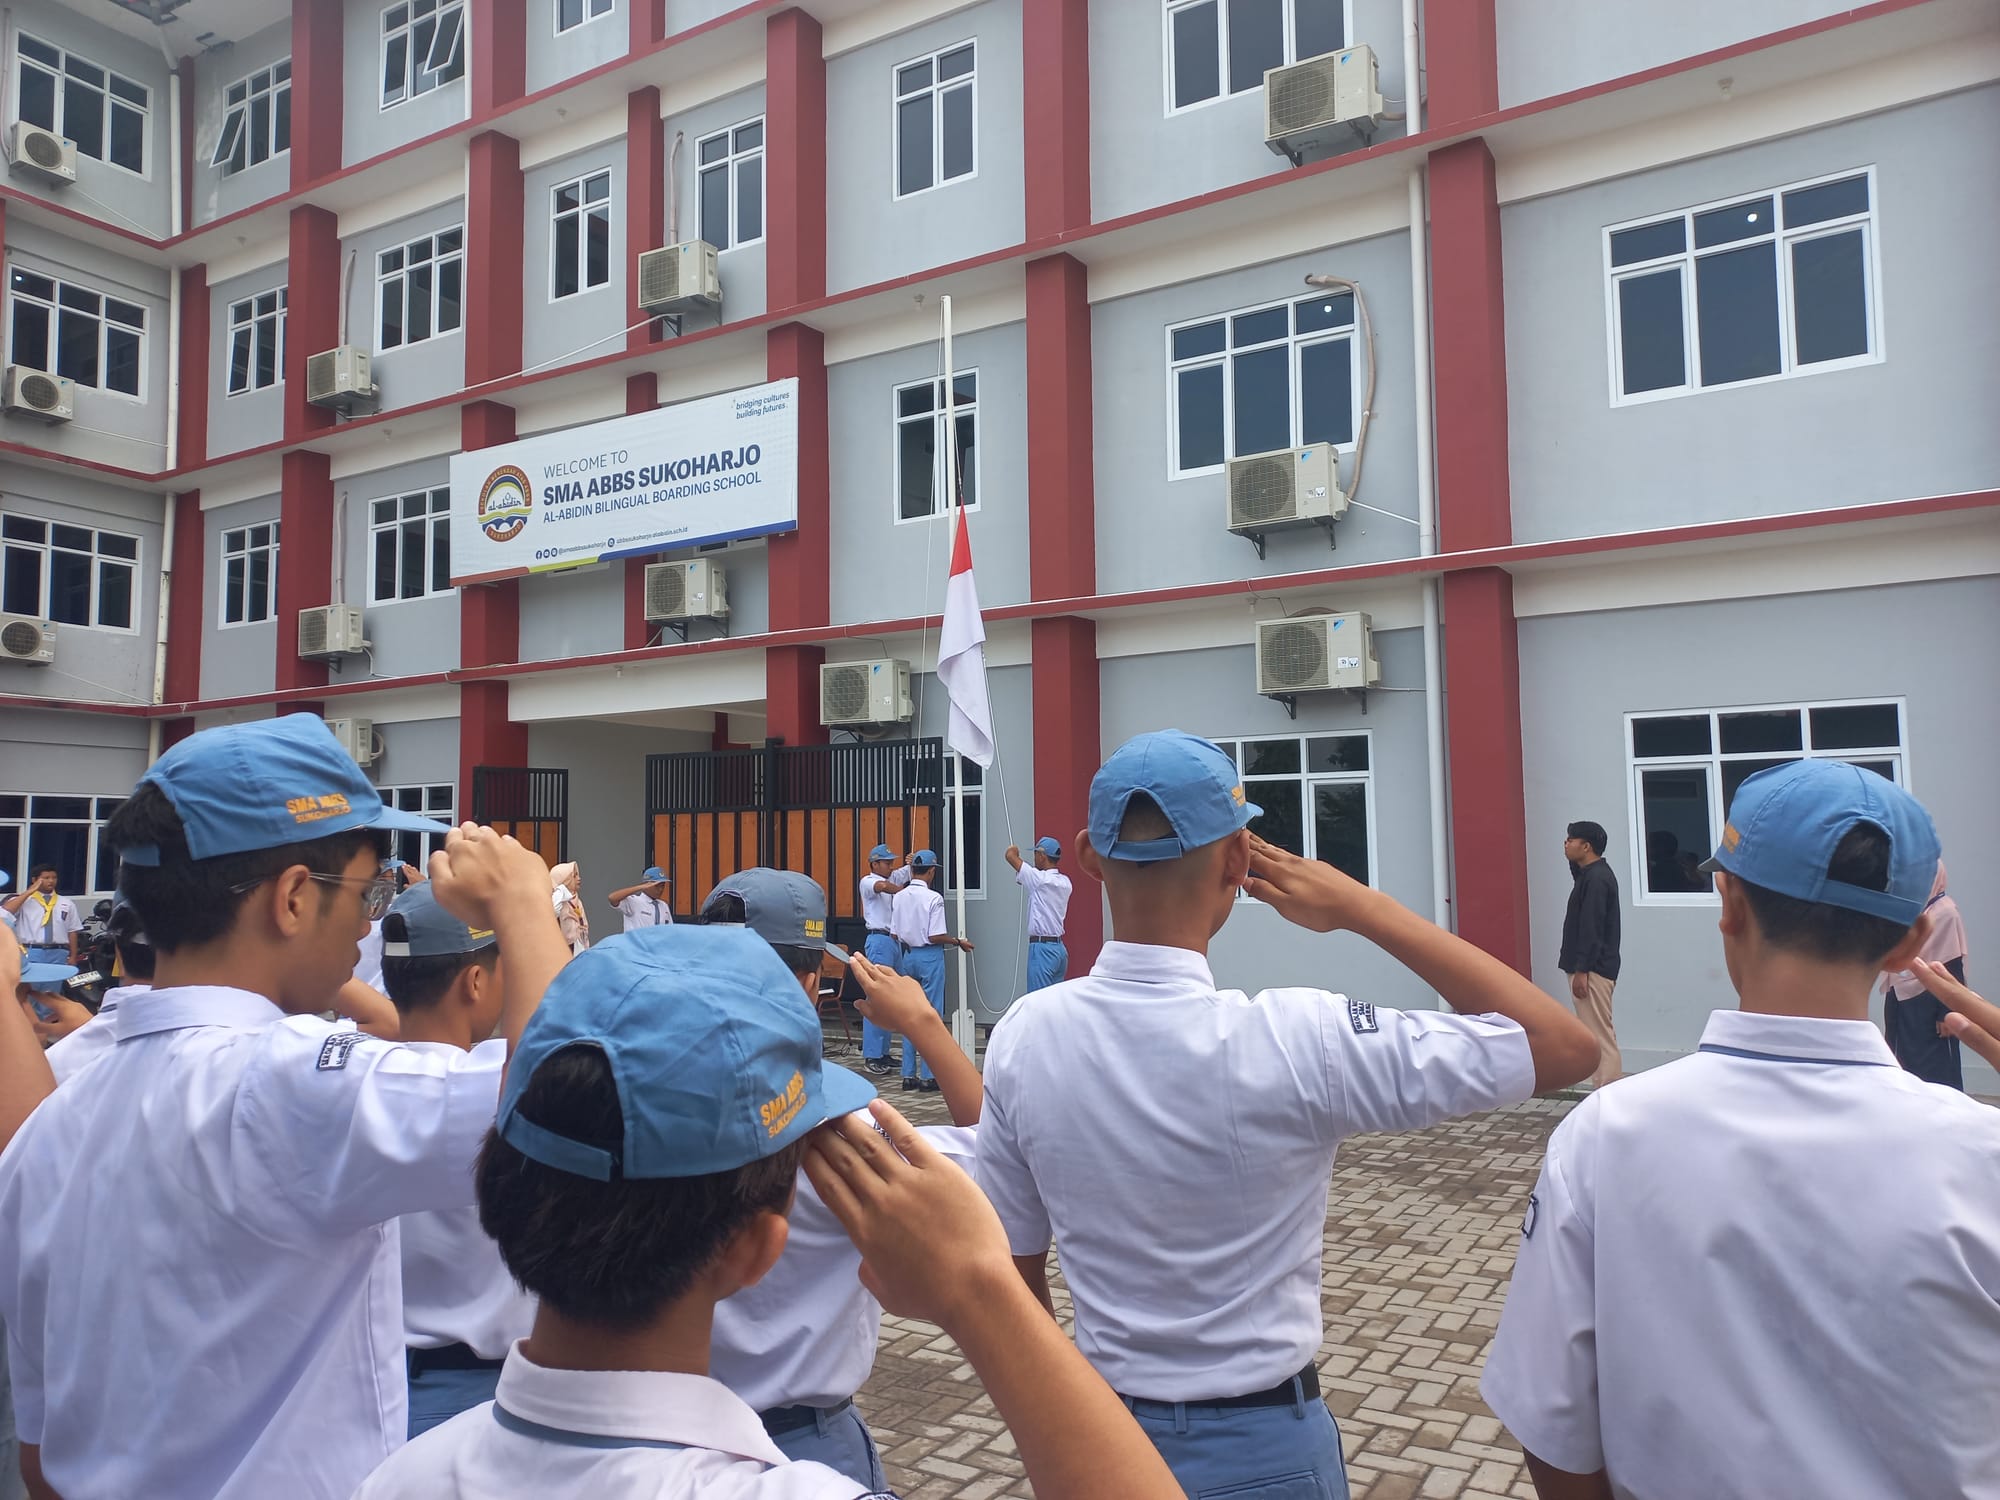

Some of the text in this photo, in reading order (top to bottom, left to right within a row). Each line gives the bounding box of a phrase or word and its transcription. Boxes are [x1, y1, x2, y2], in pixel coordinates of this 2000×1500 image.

[736, 392, 790, 410] bridging cultures
[736, 408, 762, 419] building
[543, 444, 761, 506] SMA ABBS SUKOHARJO
[544, 450, 628, 479] WELCOME TO
[543, 471, 763, 523] AL-ABIDIN BILINGUAL BOARDING SCHOOL
[286, 796, 318, 815] SMA
[760, 1092, 787, 1127] SMA
